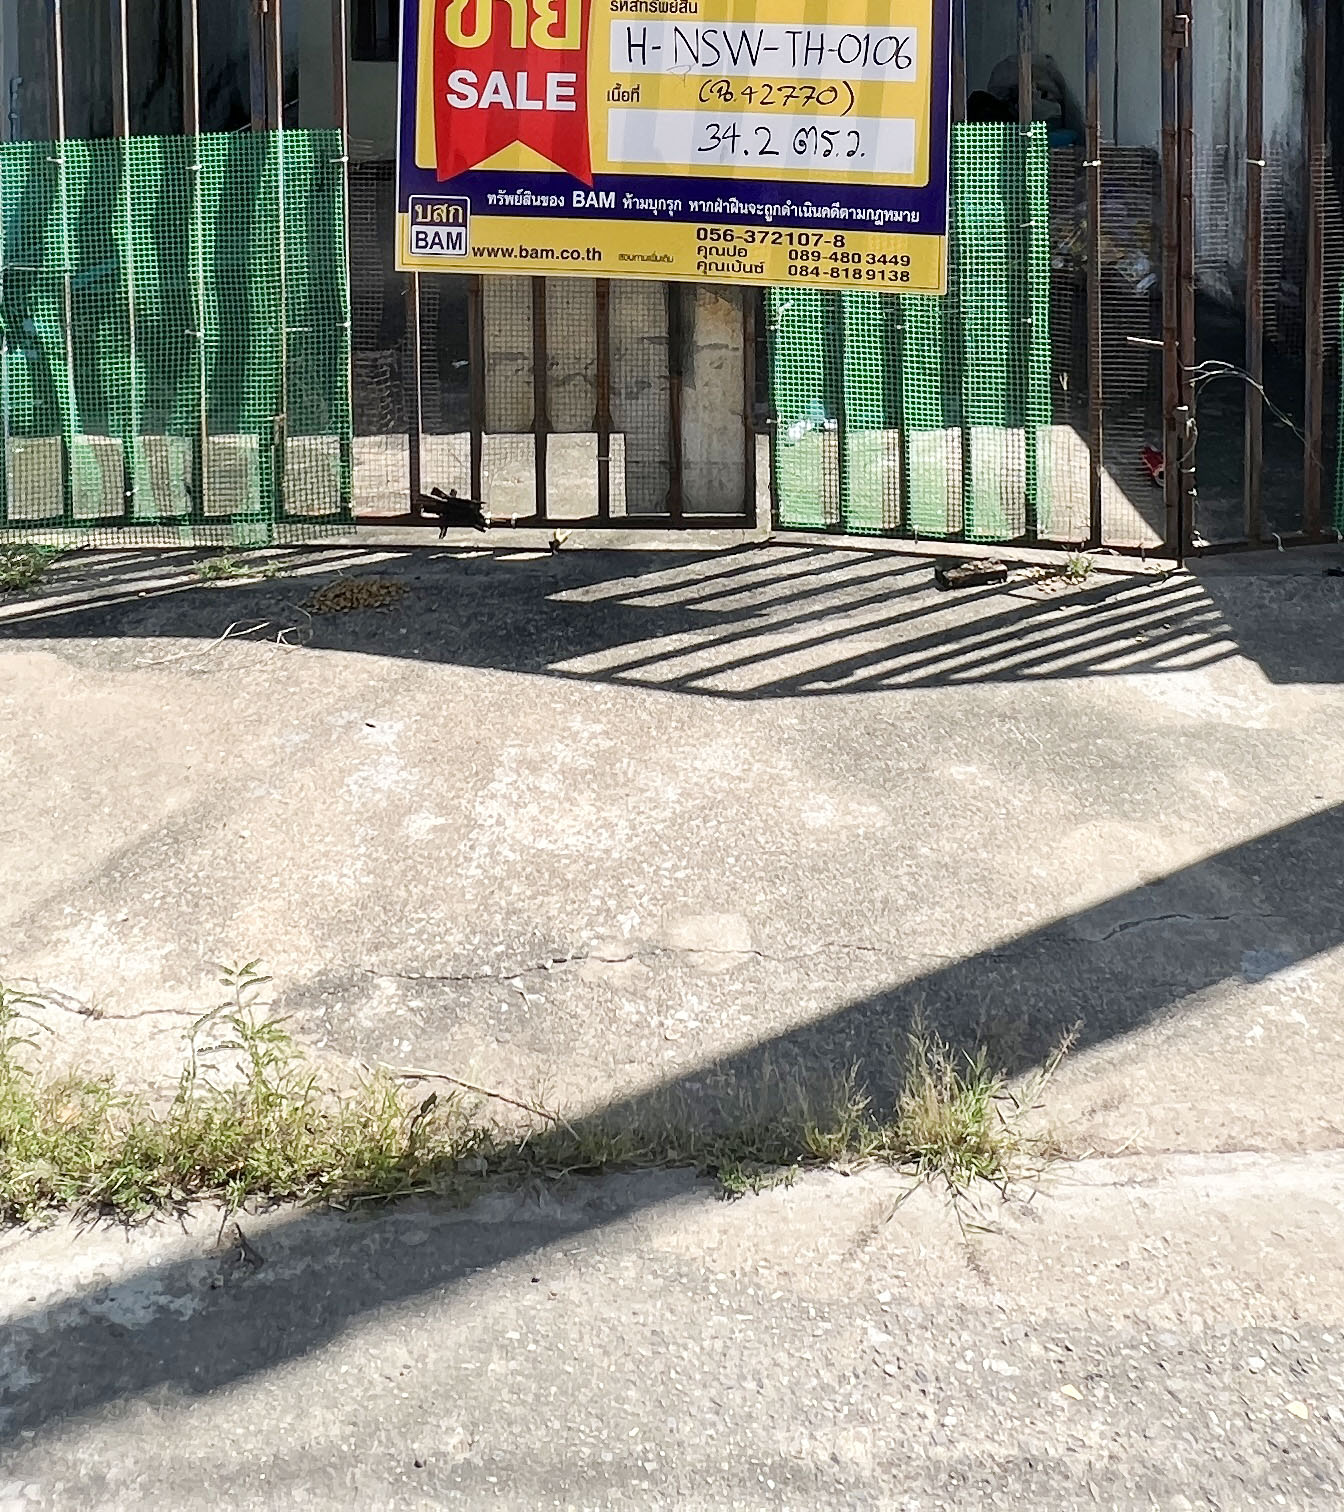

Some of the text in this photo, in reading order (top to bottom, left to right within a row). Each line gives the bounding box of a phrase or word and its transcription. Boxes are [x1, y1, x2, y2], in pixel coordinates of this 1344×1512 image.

[446, 70, 577, 112] SALE
[606, 82, 641, 103] เนื้อที่
[697, 122, 780, 156] 34.2
[414, 203, 463, 224] บสก
[487, 189, 565, 207] ทรัพย์สินของ
[572, 190, 616, 209] BAM
[622, 192, 682, 217] ห้ามบุกรุก
[415, 230, 463, 251] BAM
[696, 227, 846, 249] 056-372107-8
[471, 244, 602, 262] www.bam.co.th
